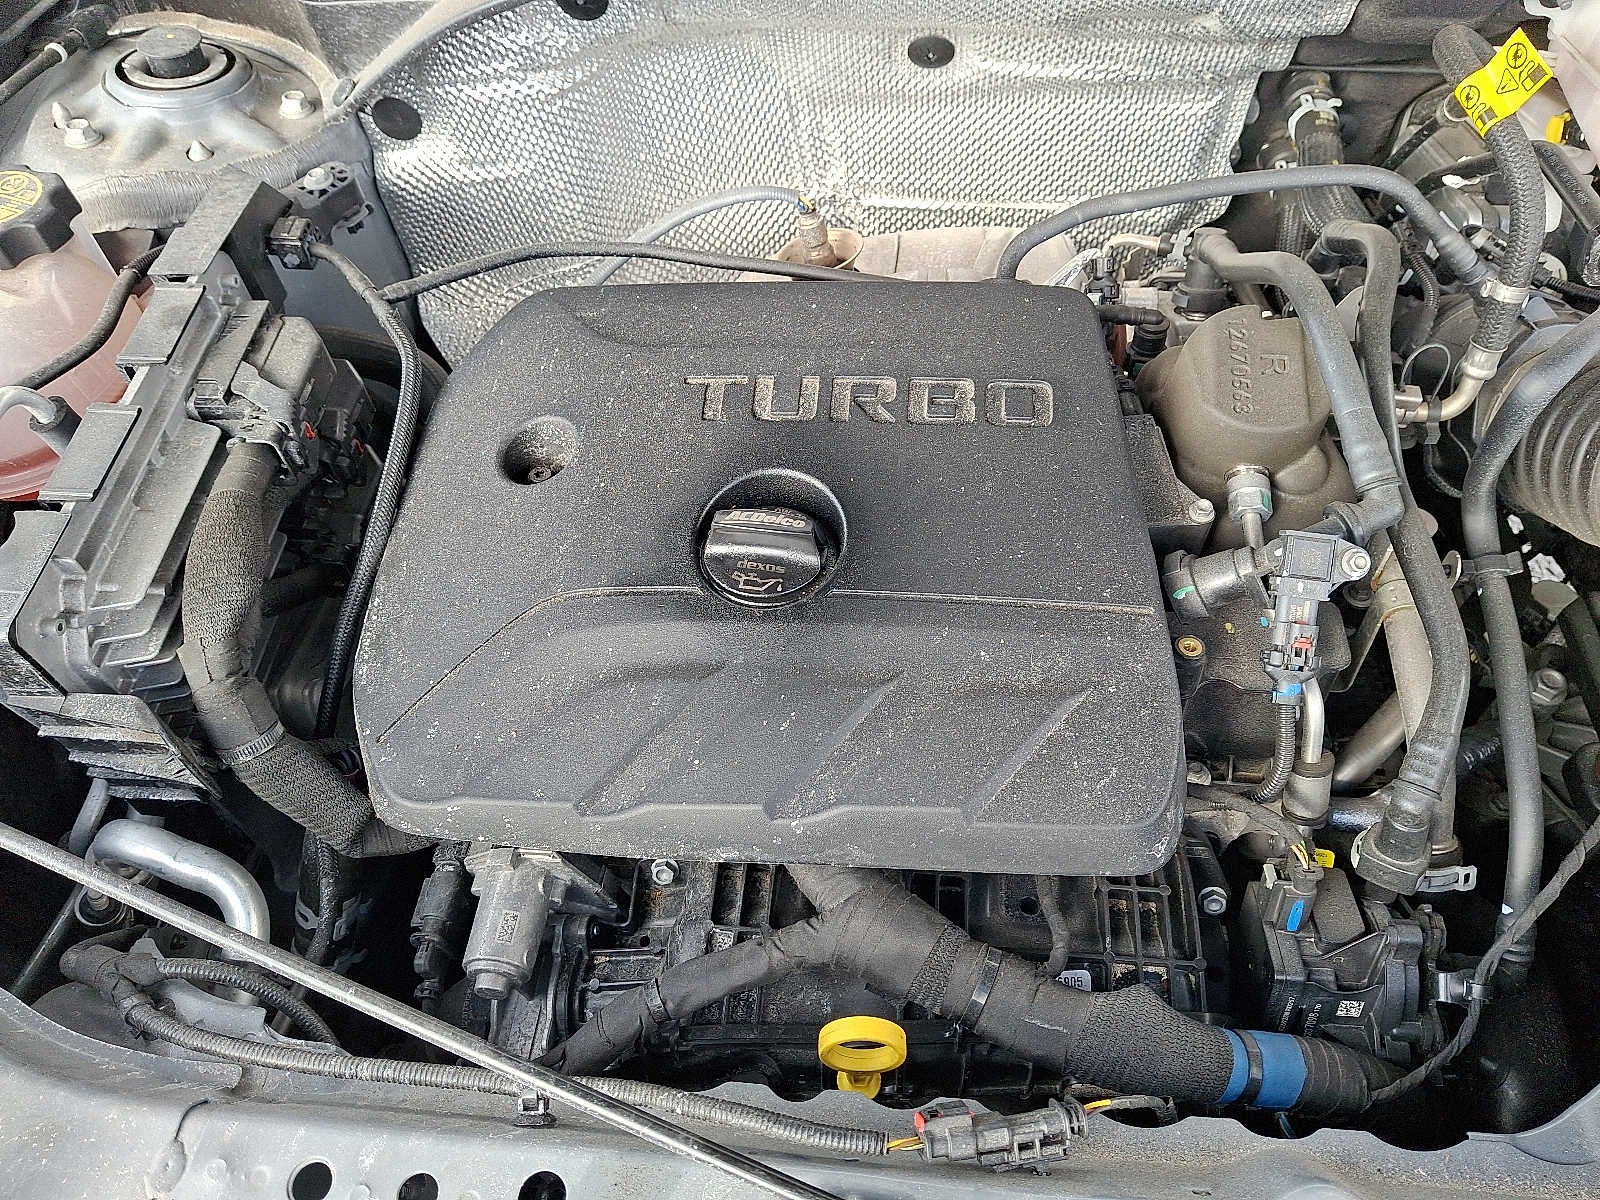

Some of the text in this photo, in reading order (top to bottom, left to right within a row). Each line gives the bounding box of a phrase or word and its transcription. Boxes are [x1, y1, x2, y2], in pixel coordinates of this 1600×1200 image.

[1228, 319, 1254, 415] 12670563
[1260, 353, 1290, 376] R
[684, 375, 1053, 427] TURBO
[725, 510, 806, 528] ACDelco
[736, 559, 786, 573] dexos
